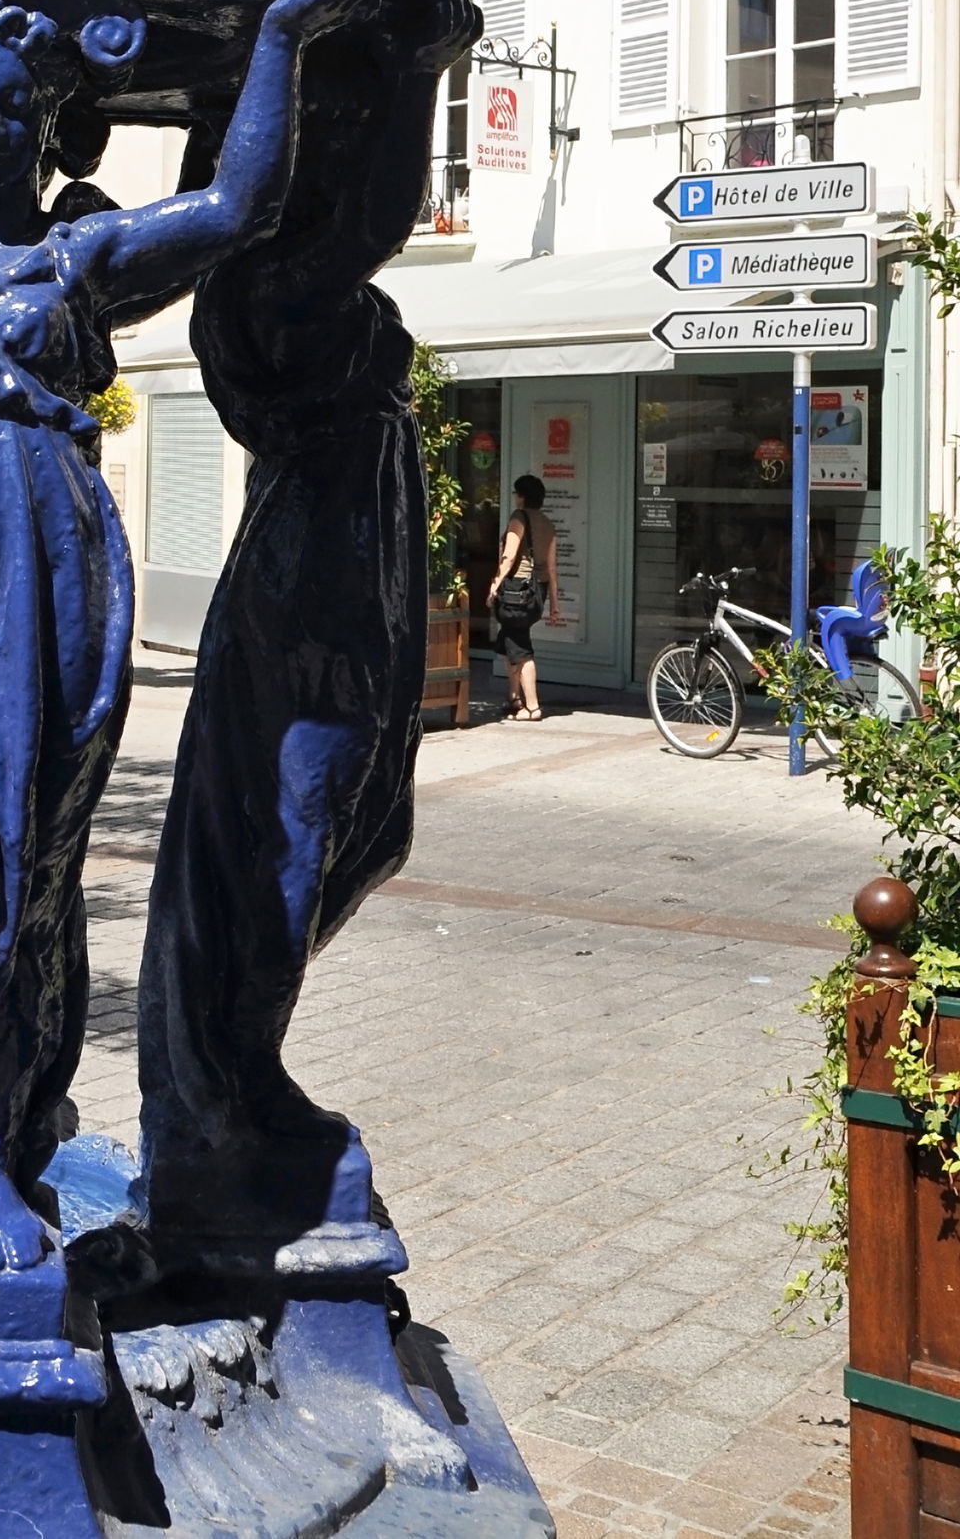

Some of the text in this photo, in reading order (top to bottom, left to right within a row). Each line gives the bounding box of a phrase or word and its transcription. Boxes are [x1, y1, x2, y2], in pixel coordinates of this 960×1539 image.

[486, 131, 518, 142] amplifon
[477, 143, 527, 159] Solutions
[477, 155, 527, 171] Auditives
[714, 184, 769, 207] Hôtel
[775, 182, 799, 202] de
[808, 179, 854, 201] Ville
[731, 251, 854, 276] Médiathèque
[681, 317, 854, 341] Salon Richelieu
